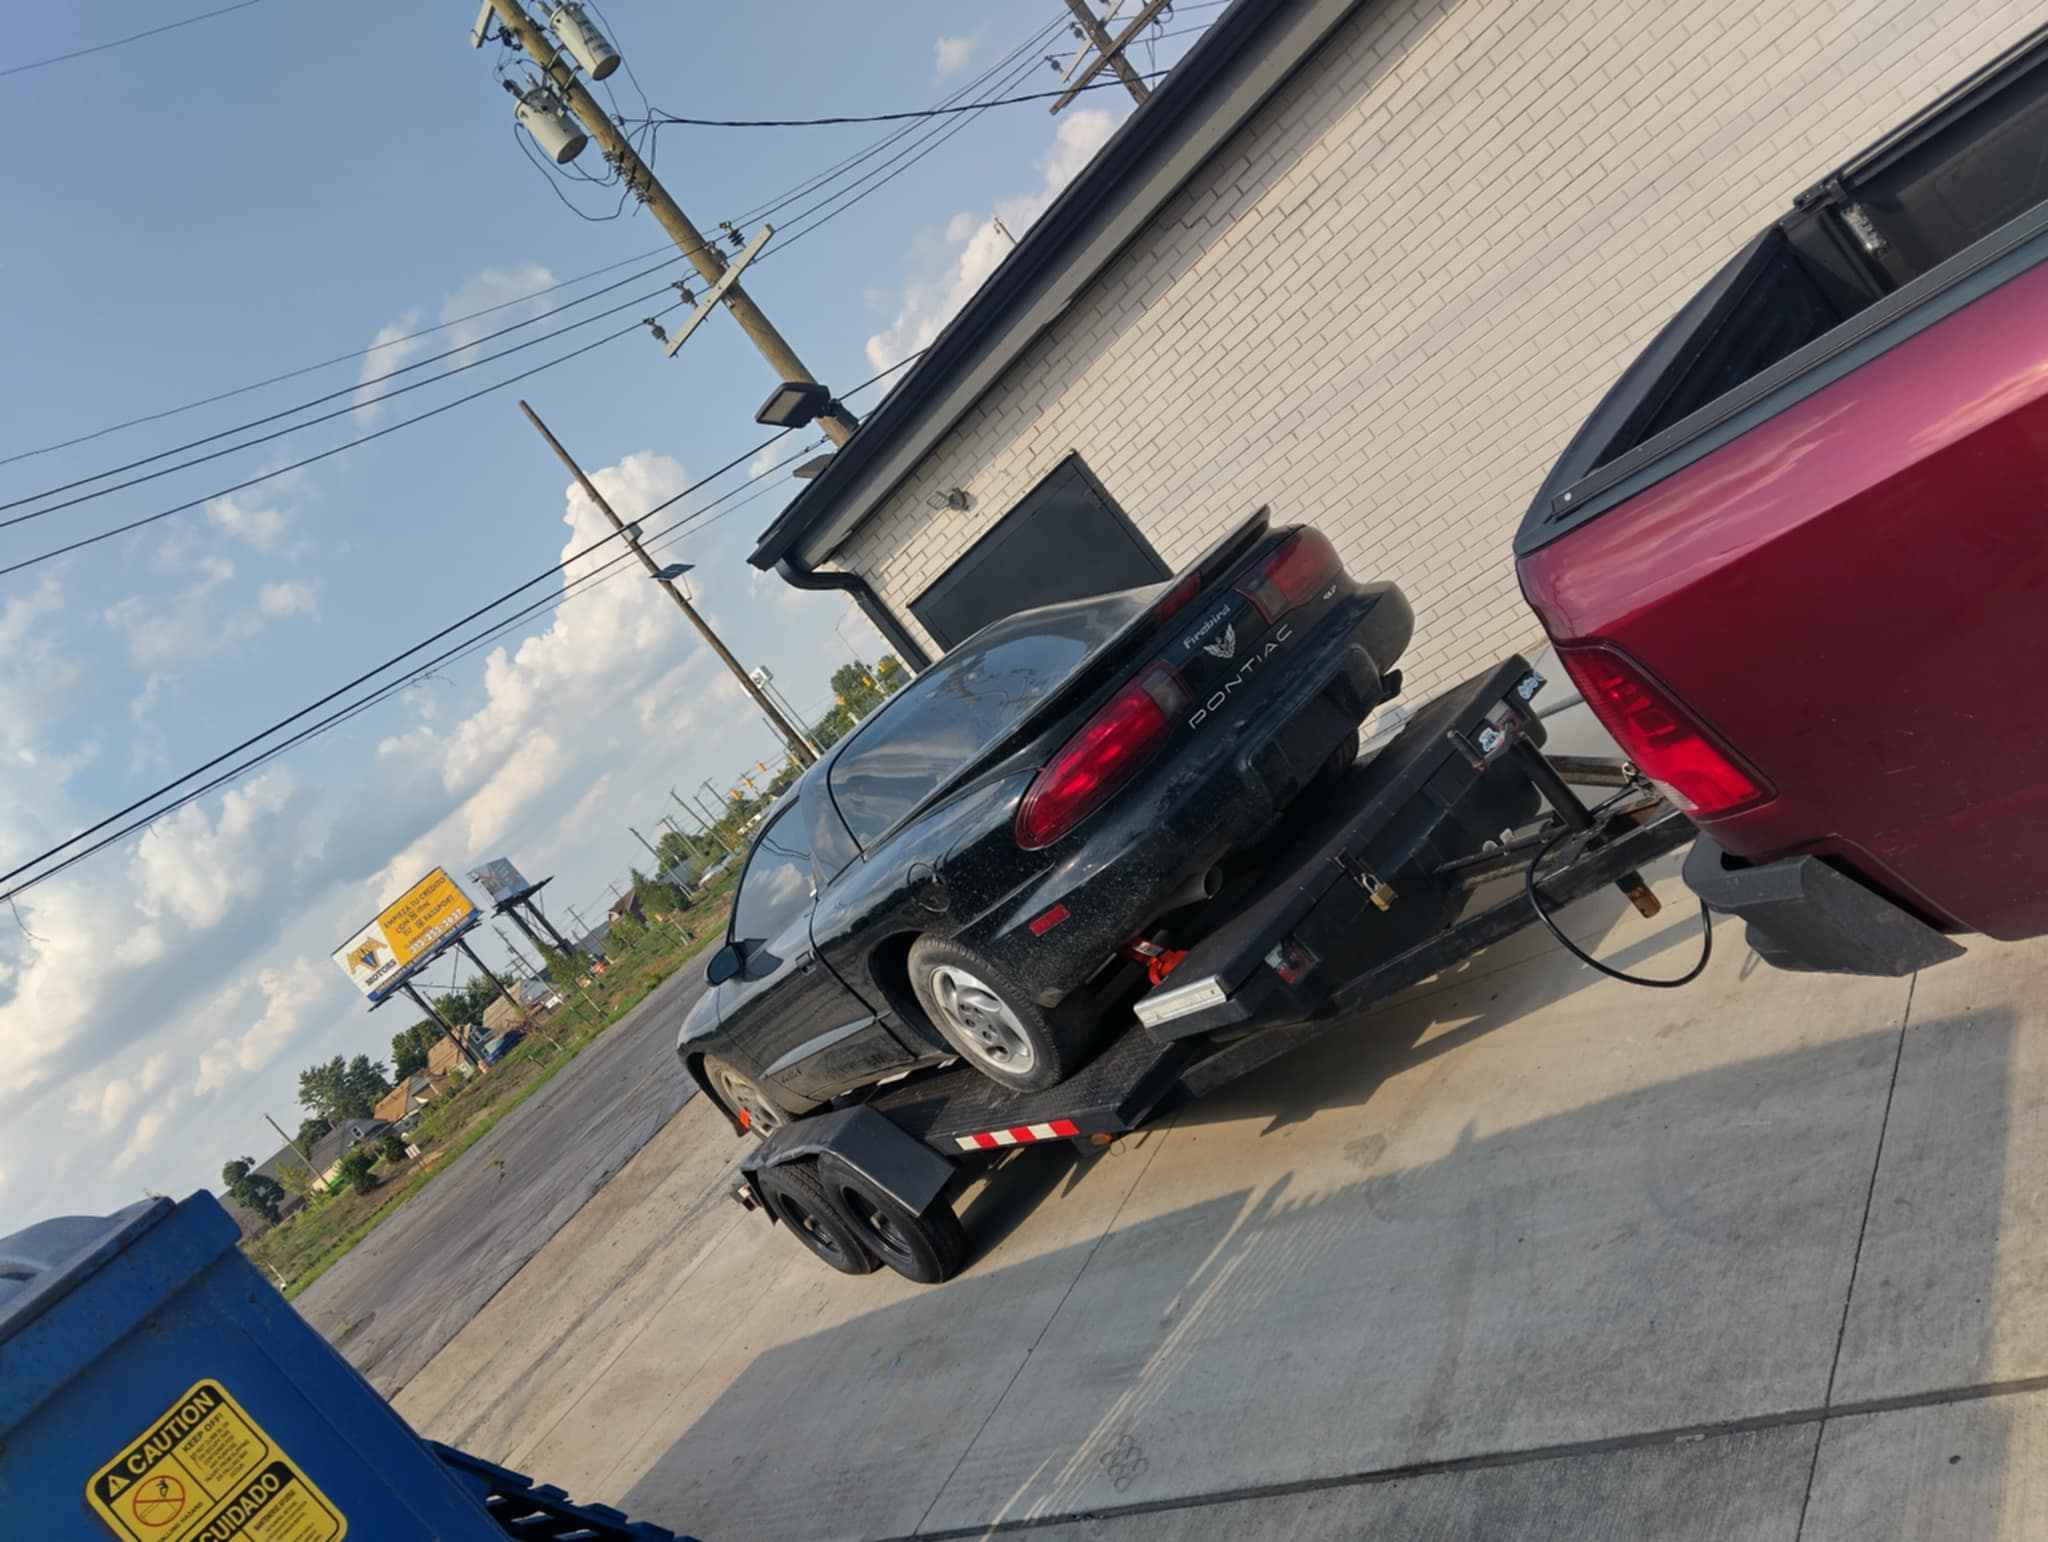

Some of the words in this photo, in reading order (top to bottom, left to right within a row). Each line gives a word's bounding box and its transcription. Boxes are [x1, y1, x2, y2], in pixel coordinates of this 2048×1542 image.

[1183, 604, 1231, 649] Firebird
[1188, 624, 1293, 729] PONTIAC
[127, 1391, 215, 1475] CAUTION
[183, 1430, 204, 1453] KEEP
[201, 1472, 280, 1542] CUIDADO
